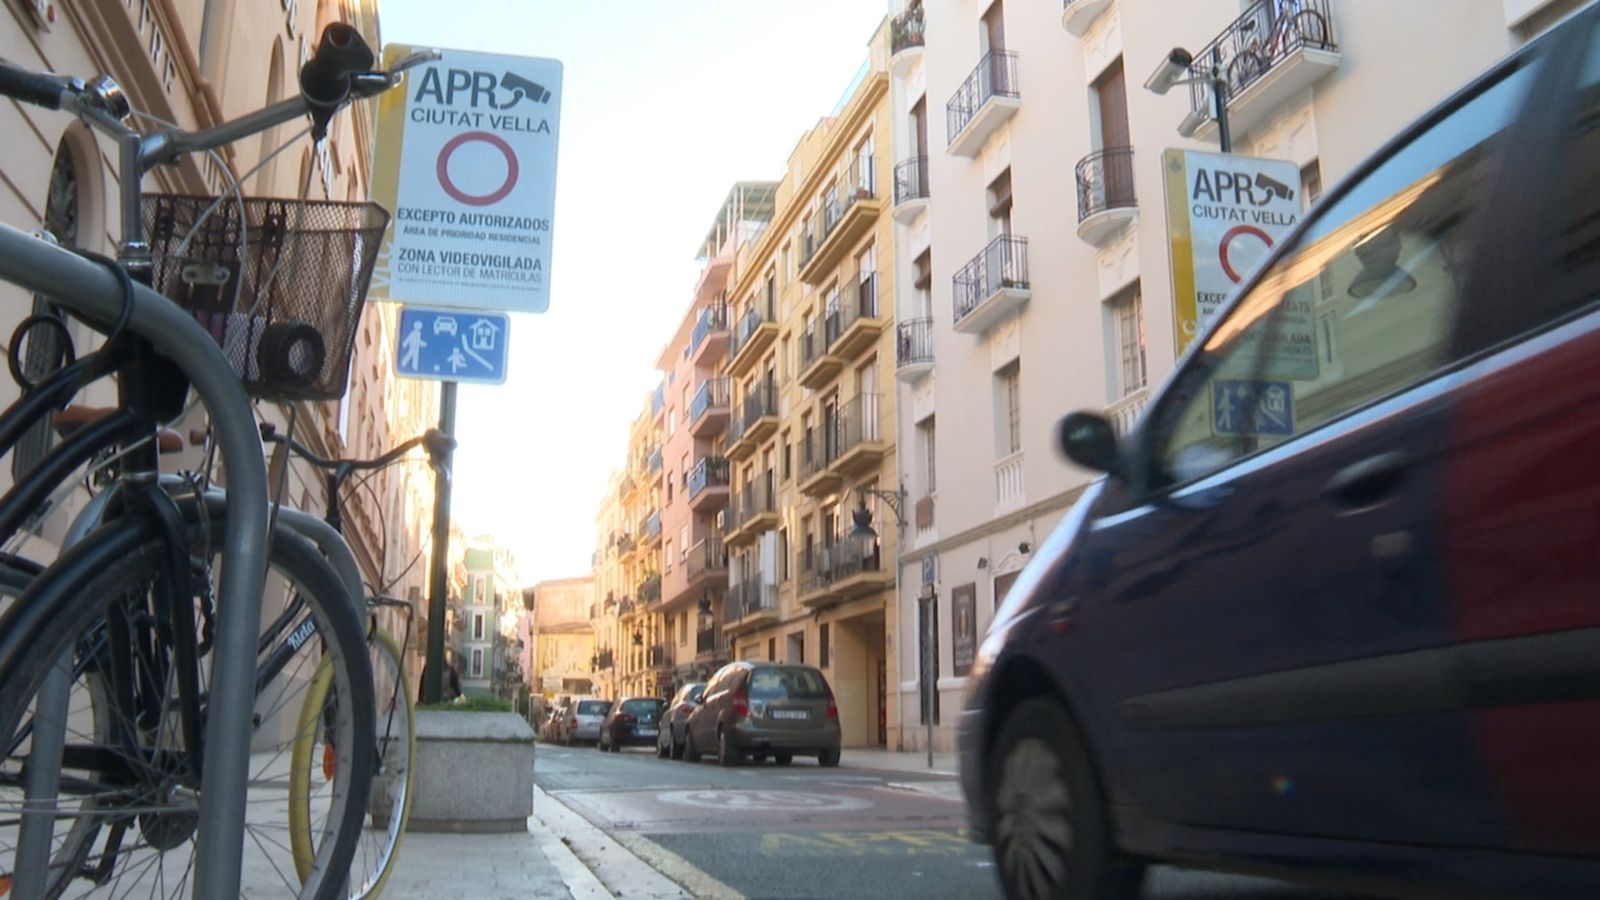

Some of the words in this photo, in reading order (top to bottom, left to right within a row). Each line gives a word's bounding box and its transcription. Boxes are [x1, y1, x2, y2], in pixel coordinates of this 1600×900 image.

[414, 66, 498, 110] APR
[411, 107, 484, 128] CIUTAT
[489, 115, 551, 134] VELLA
[1192, 168, 1257, 206] APR
[397, 207, 456, 224] EXCEPTO
[459, 212, 550, 231] AUTORIZADOS
[1192, 203, 1247, 223] CIUTAT
[1250, 210, 1297, 227] VELLA
[428, 227, 439, 237] DE
[441, 229, 486, 241] PRIORIDAD
[488, 232, 541, 246] RESIDENCIAL
[398, 247, 435, 263] ZONA
[440, 250, 543, 271] VIDEOVIGILADA
[397, 261, 420, 274] CON
[422, 263, 461, 278] LECTOR
[463, 266, 477, 279] DE
[479, 267, 543, 284] MATRÍCULAS
